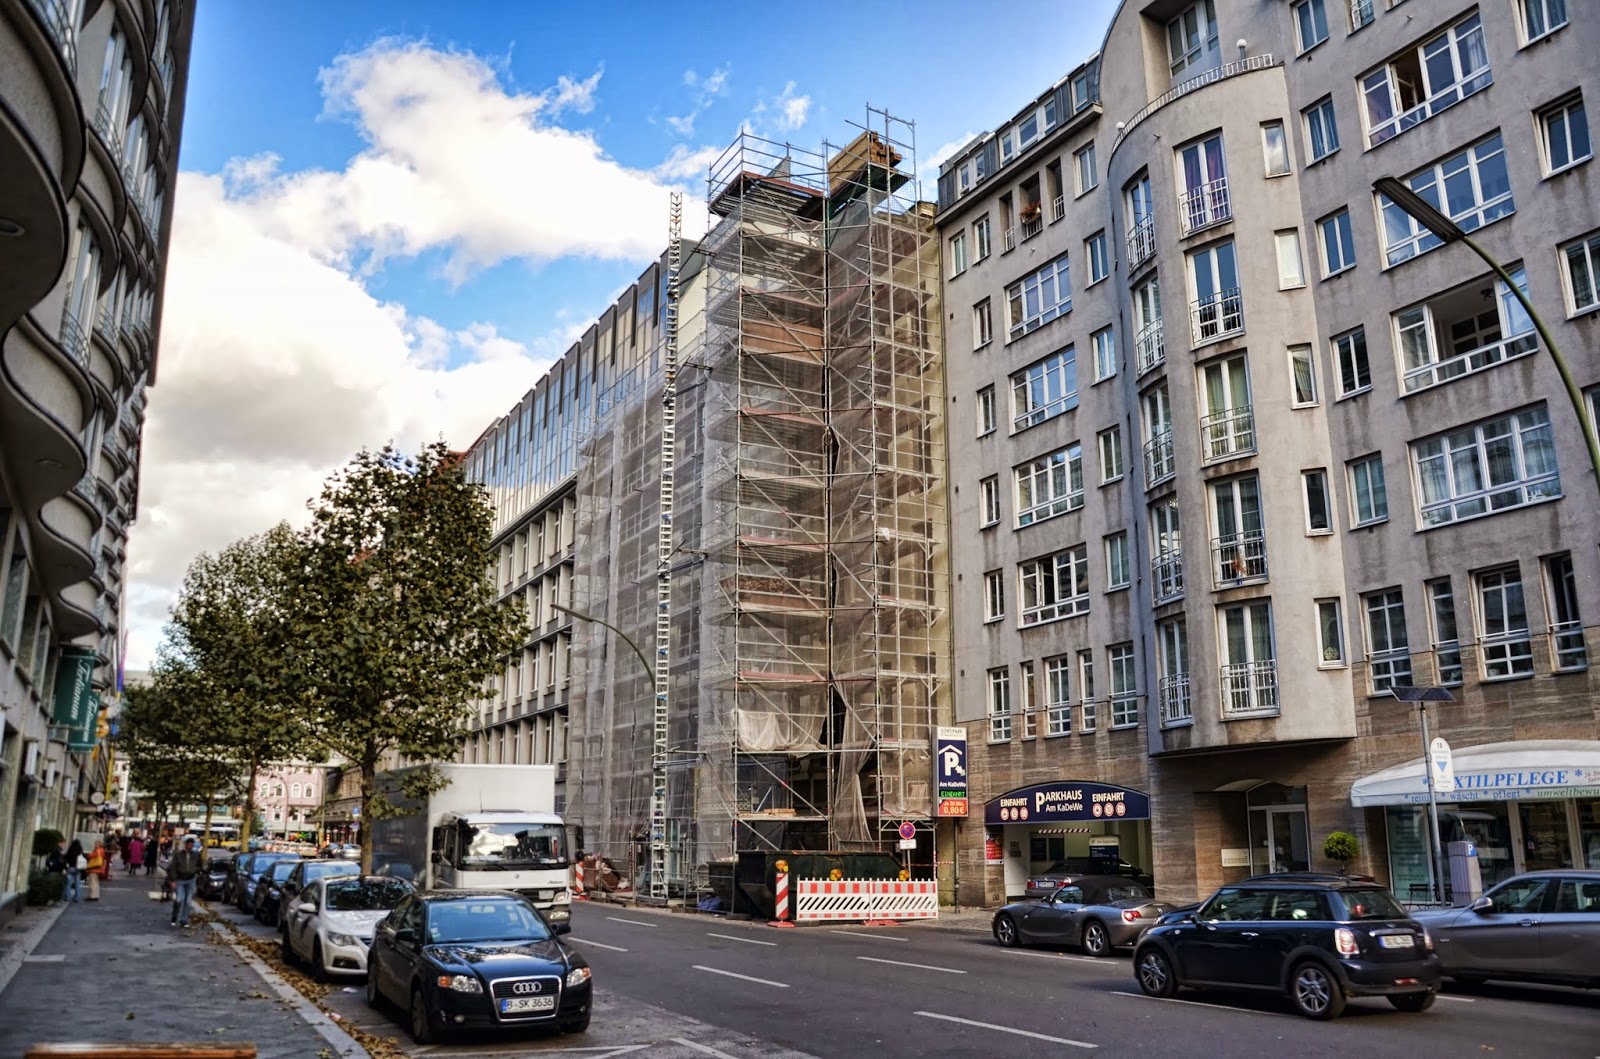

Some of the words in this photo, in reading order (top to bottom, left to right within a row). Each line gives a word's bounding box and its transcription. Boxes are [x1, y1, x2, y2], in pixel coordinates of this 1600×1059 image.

[70, 658, 91, 721] Tertianum
[944, 751, 960, 777] P
[1453, 770, 1569, 789] XTILPFLEGE
[1000, 797, 1028, 808] EINFAHRT
[1035, 790, 1083, 813] PARKHAUS
[1092, 792, 1125, 803] EINFAHRT
[1411, 793, 1437, 803] reinit
[1449, 791, 1479, 800] wäscht
[1492, 789, 1521, 800] pflegt
[1045, 804, 1056, 813] Am
[1057, 802, 1083, 812] KaDeWe
[1467, 843, 1473, 856] P
[532, 997, 553, 1008] 3636
